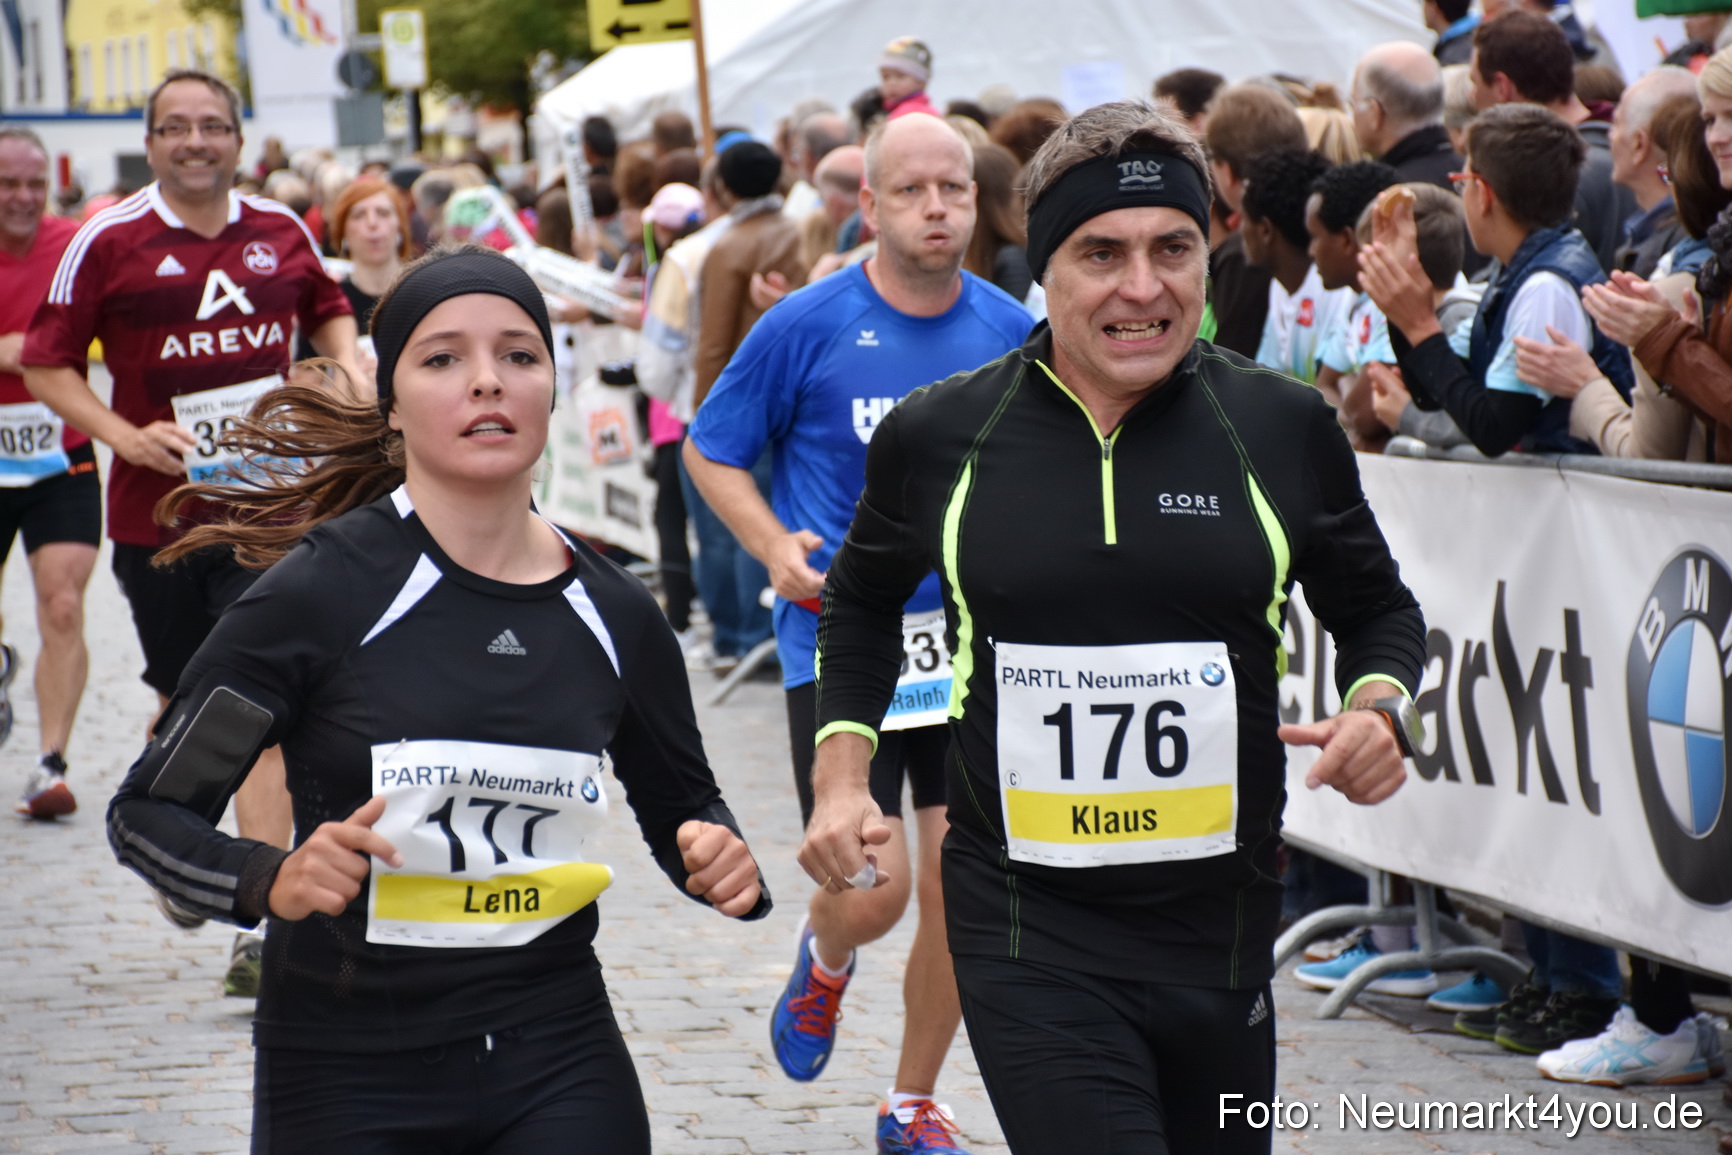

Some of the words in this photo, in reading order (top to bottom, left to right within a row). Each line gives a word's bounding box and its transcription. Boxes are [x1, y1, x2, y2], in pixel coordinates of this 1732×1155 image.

[1117, 160, 1162, 176] TAO
[160, 321, 284, 359] AREVA
[1158, 493, 1220, 509] GORE
[1160, 507, 1198, 515] RUNNING
[1200, 509, 1221, 517] WEAR
[487, 643, 527, 656] adidas
[1002, 666, 1071, 689] PARTL
[1078, 667, 1192, 690] Neumarkt
[891, 686, 946, 711] Ralph
[1043, 699, 1190, 781] 176
[380, 766, 462, 787] PARTL
[468, 768, 575, 799] Neumarkt
[1071, 805, 1158, 836] Klaus
[425, 795, 561, 874] 177
[463, 885, 540, 914] Lena
